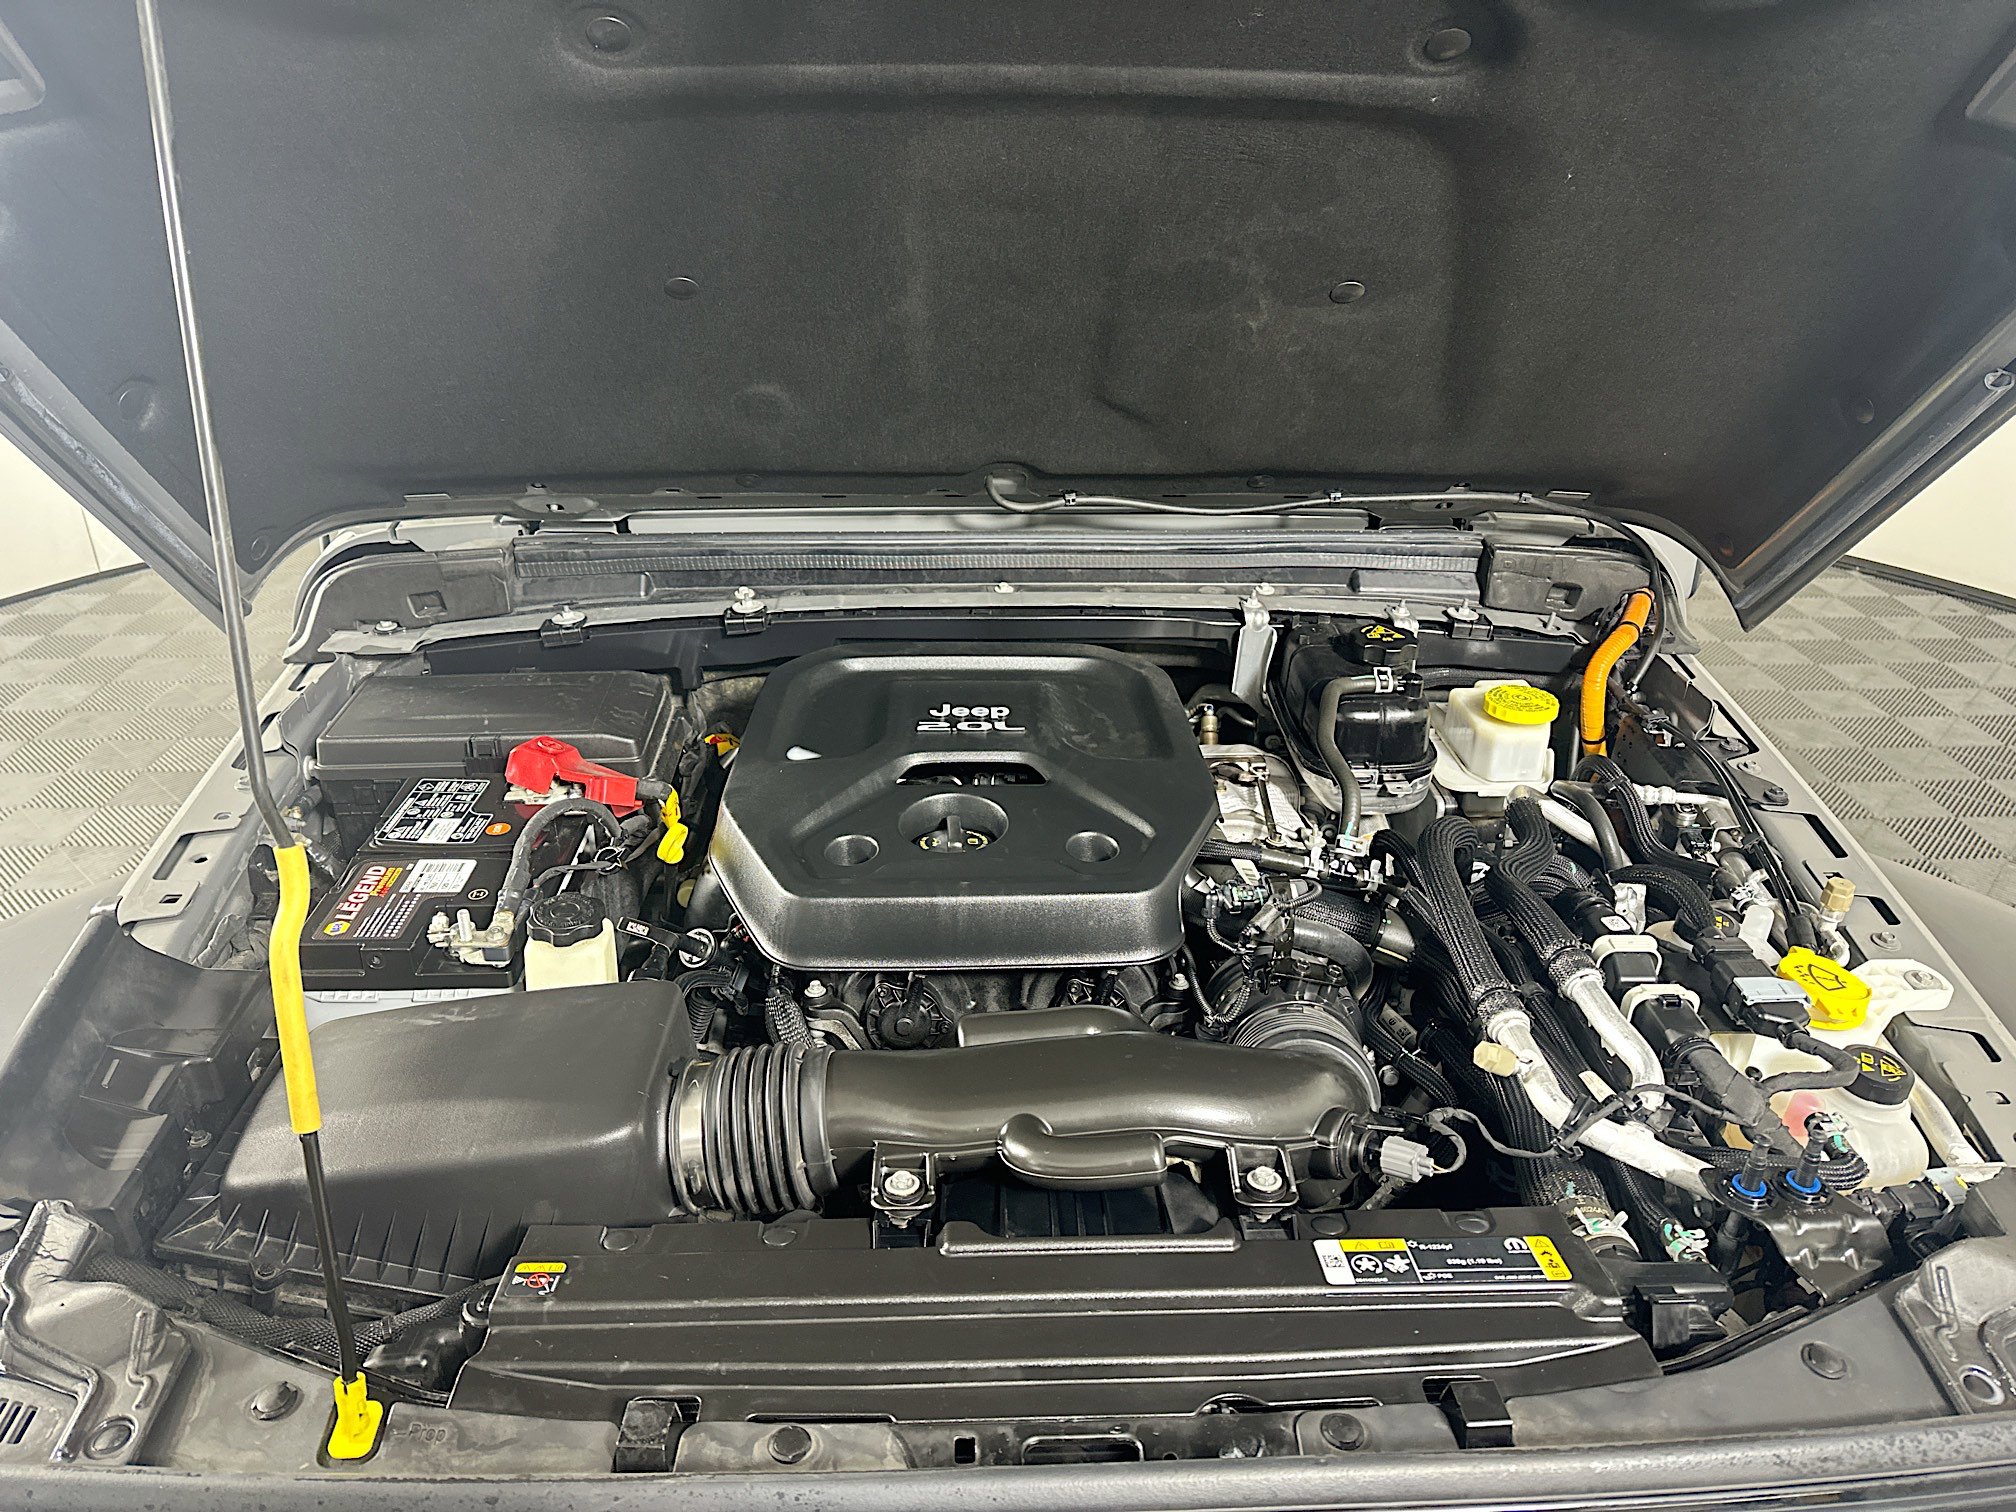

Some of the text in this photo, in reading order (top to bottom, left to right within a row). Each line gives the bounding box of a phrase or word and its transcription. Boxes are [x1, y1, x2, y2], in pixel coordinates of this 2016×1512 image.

[929, 703, 1010, 719] Jeep
[916, 721, 1026, 732] 2.0L
[334, 865, 387, 921] LEGEND
